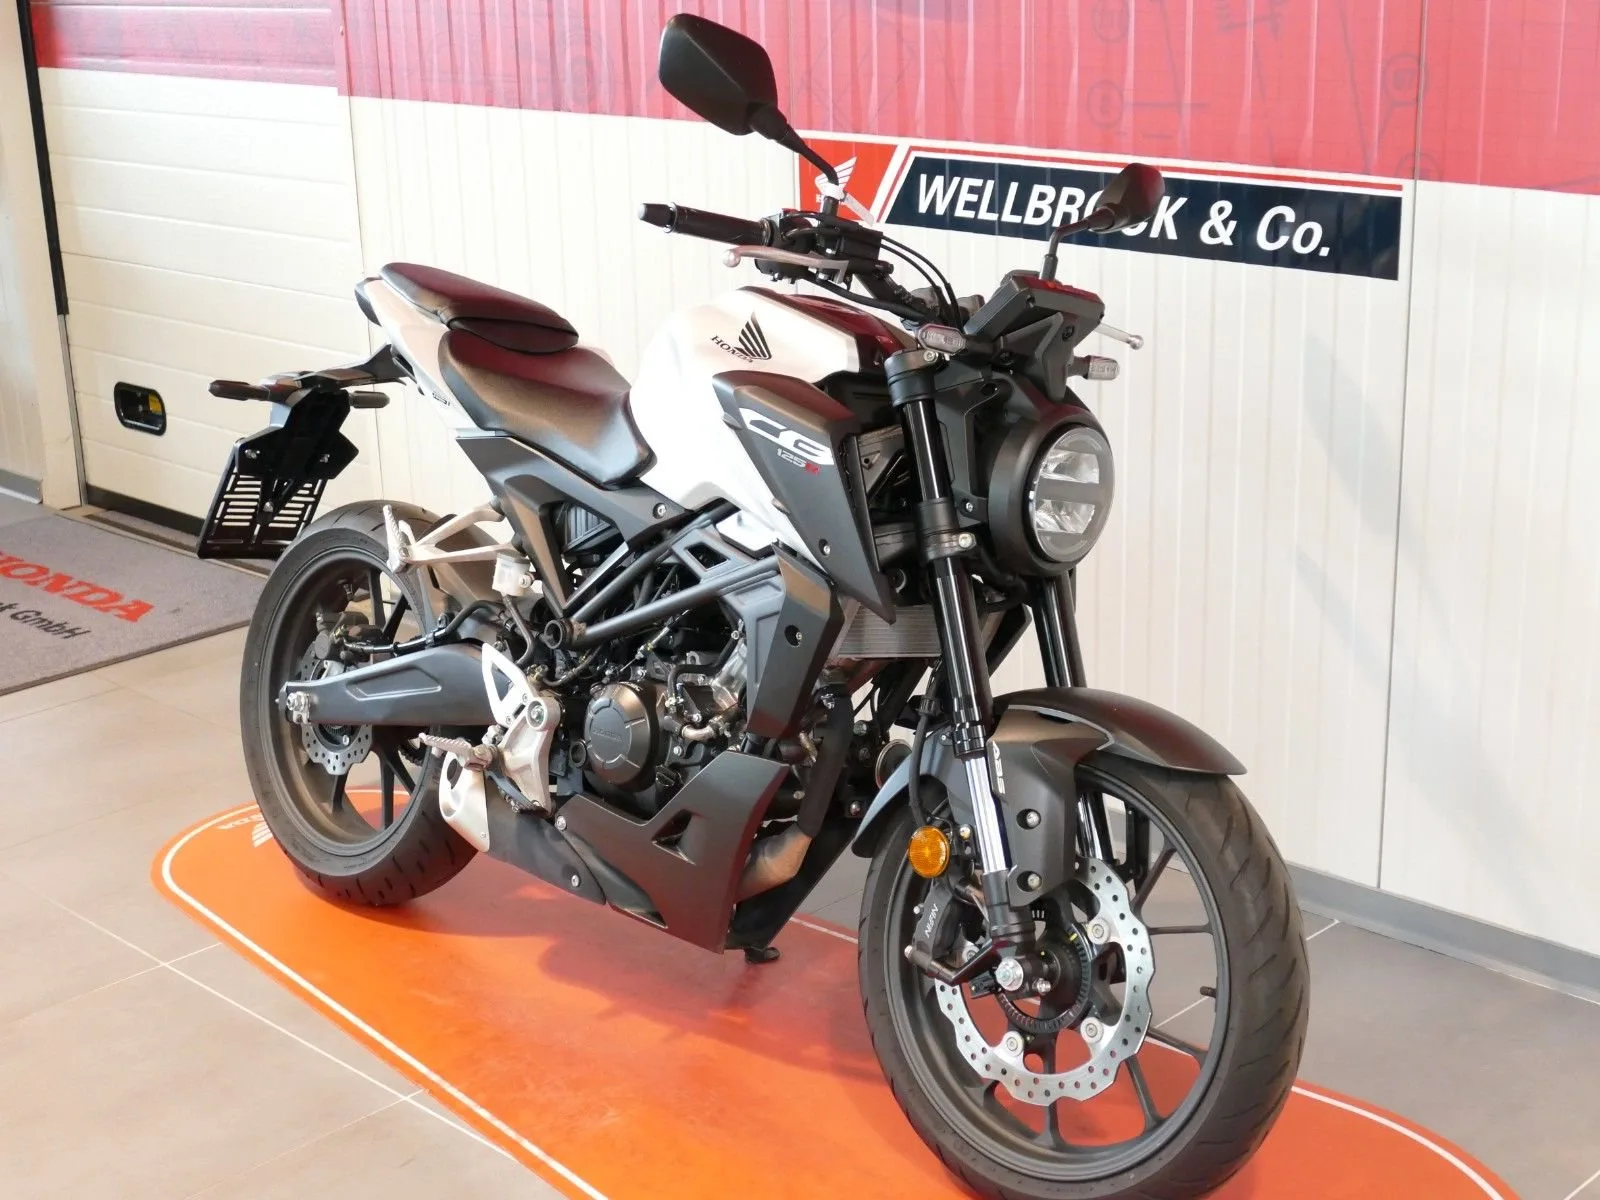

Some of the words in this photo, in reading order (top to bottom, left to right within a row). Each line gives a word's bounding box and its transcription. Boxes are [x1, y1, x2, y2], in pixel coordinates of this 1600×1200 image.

[918, 173, 1188, 240] WELLBRK
[1200, 200, 1237, 245] &
[1256, 205, 1330, 257] Co.
[710, 335, 754, 363] HONDA
[777, 448, 820, 475] 125R
[10, 610, 91, 639] GmbH
